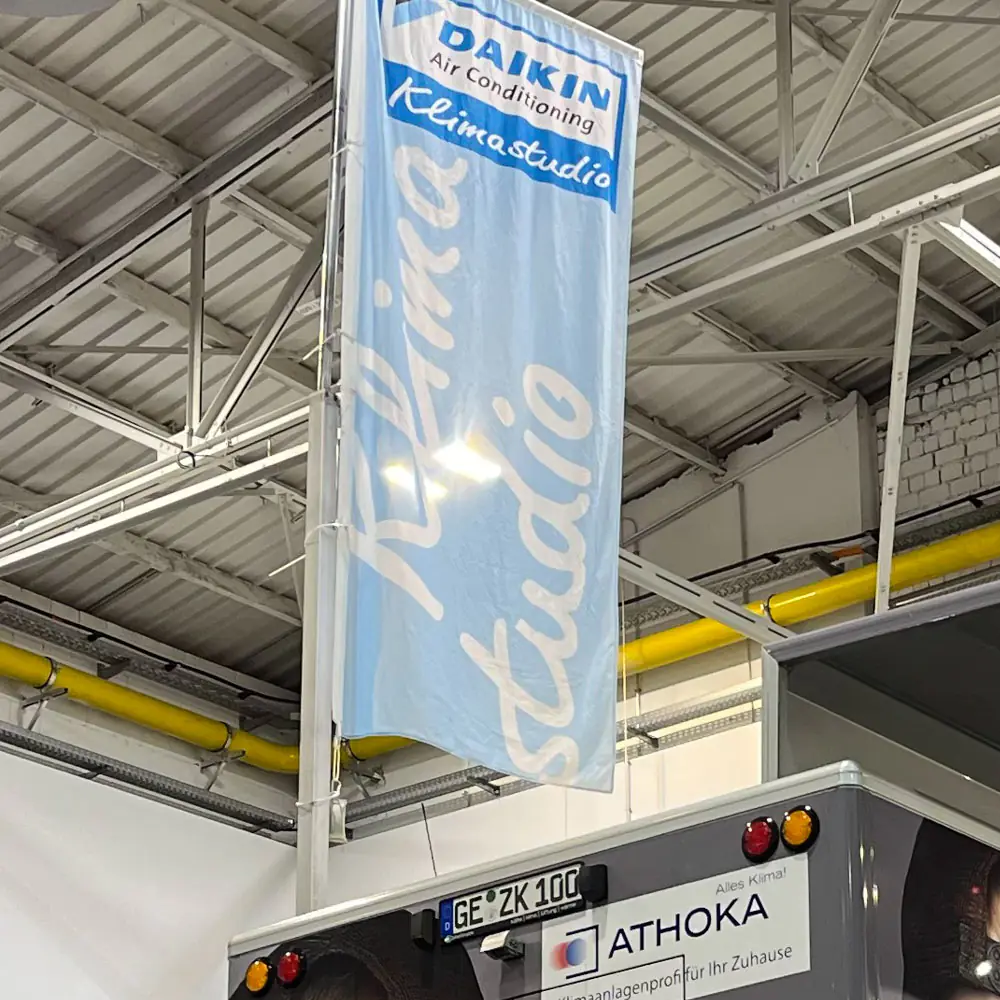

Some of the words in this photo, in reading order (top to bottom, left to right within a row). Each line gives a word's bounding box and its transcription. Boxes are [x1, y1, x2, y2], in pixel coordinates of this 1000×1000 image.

[429, 51, 461, 77] Air
[465, 66, 596, 137] Conditioning
[438, 20, 611, 112] DAIKIN
[388, 76, 612, 190] Klimastudio
[460, 363, 594, 786] studio
[454, 896, 484, 930] GE
[499, 882, 529, 917] ZK
[535, 869, 580, 908] 100
[715, 880, 745, 896] Alles
[748, 867, 787, 888] Klima!
[608, 893, 769, 959] ATHOKA
[684, 965, 705, 983] für
[708, 959, 727, 977] Ihr
[731, 945, 793, 972] Zuhause
